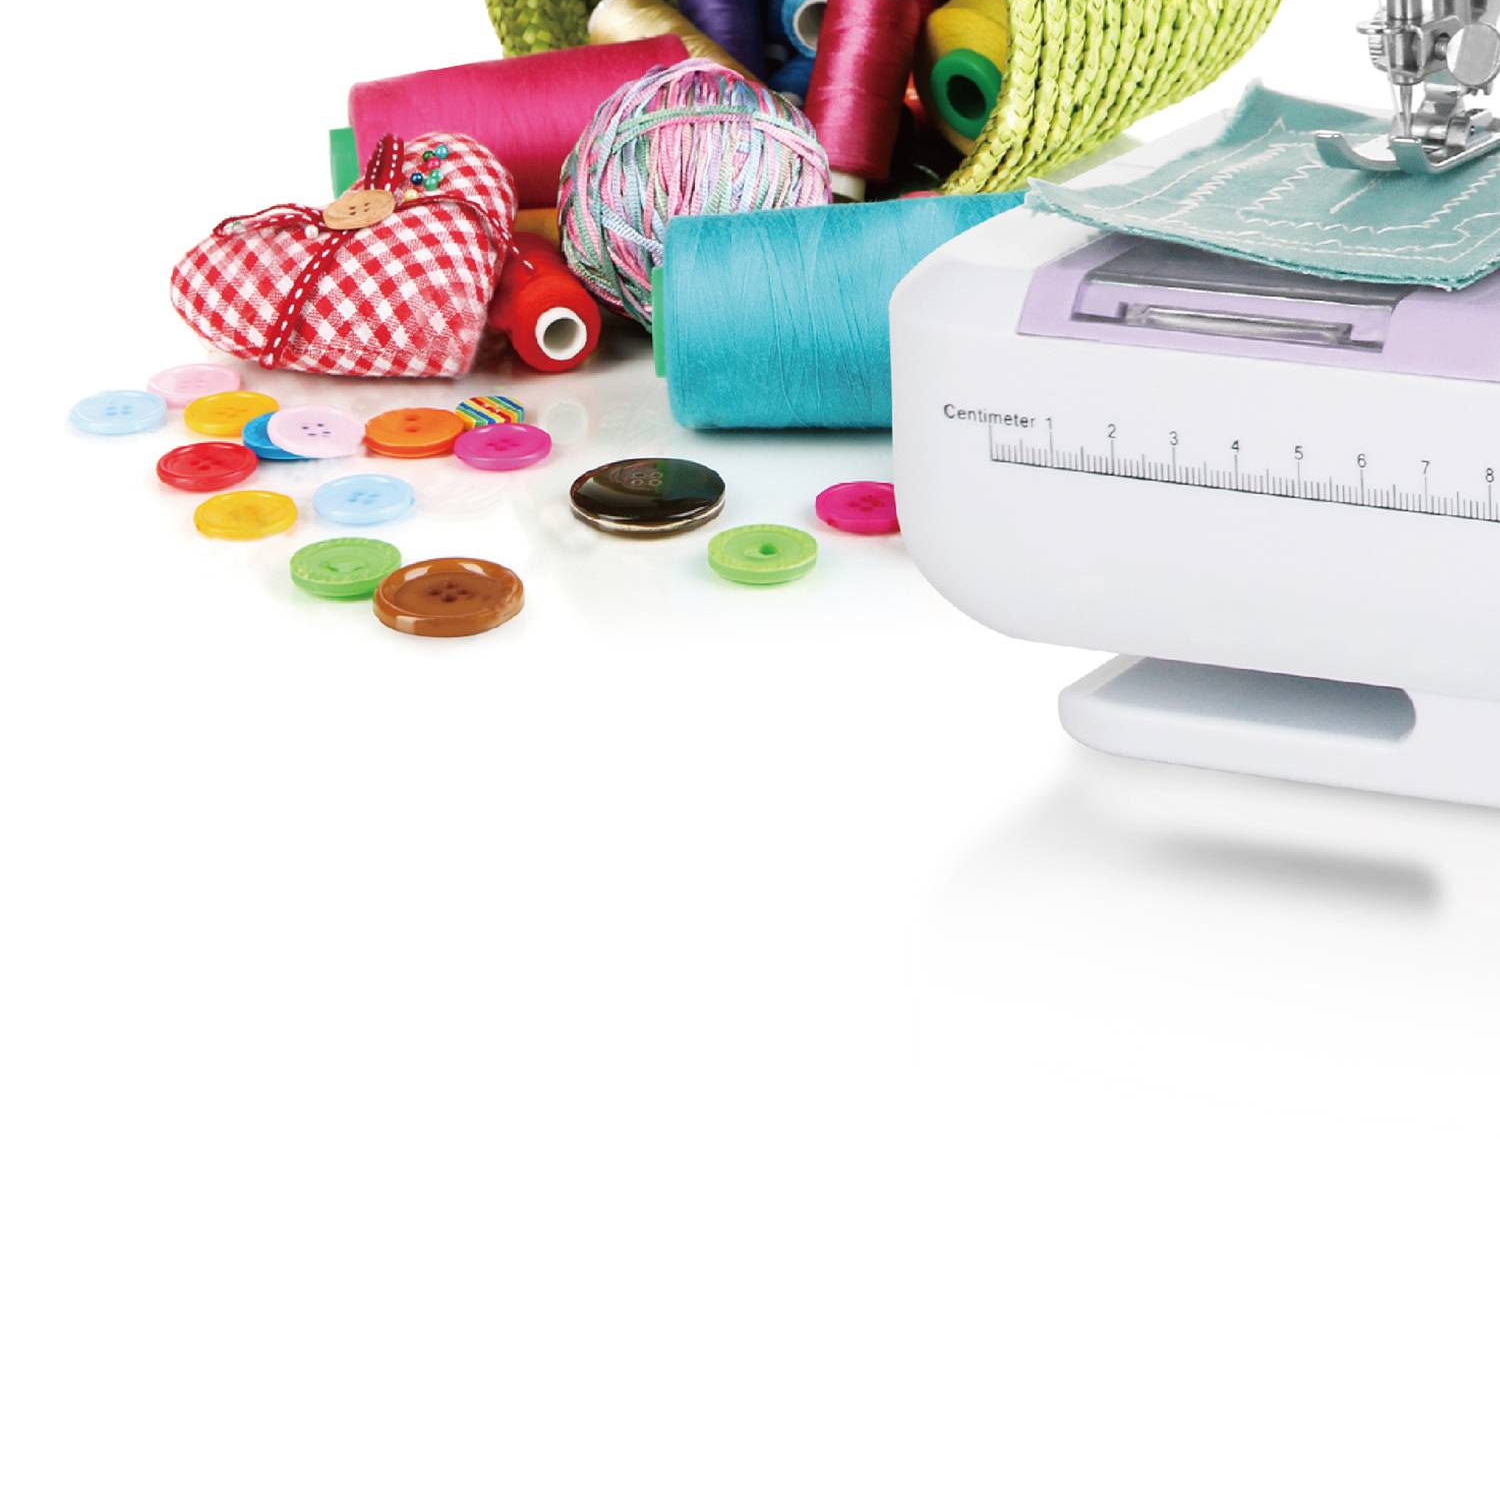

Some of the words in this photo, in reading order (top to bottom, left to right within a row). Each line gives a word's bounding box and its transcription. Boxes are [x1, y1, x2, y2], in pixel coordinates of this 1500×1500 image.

[944, 404, 1035, 428] Centimeter
[1045, 416, 1053, 431] 1
[1106, 423, 1118, 439] 2
[1169, 430, 1179, 446] 3
[1230, 438, 1241, 454] 4
[1293, 445, 1304, 461] 5
[1356, 453, 1367, 469] 6
[1420, 459, 1432, 476] 7
[1484, 467, 1496, 484] 8
